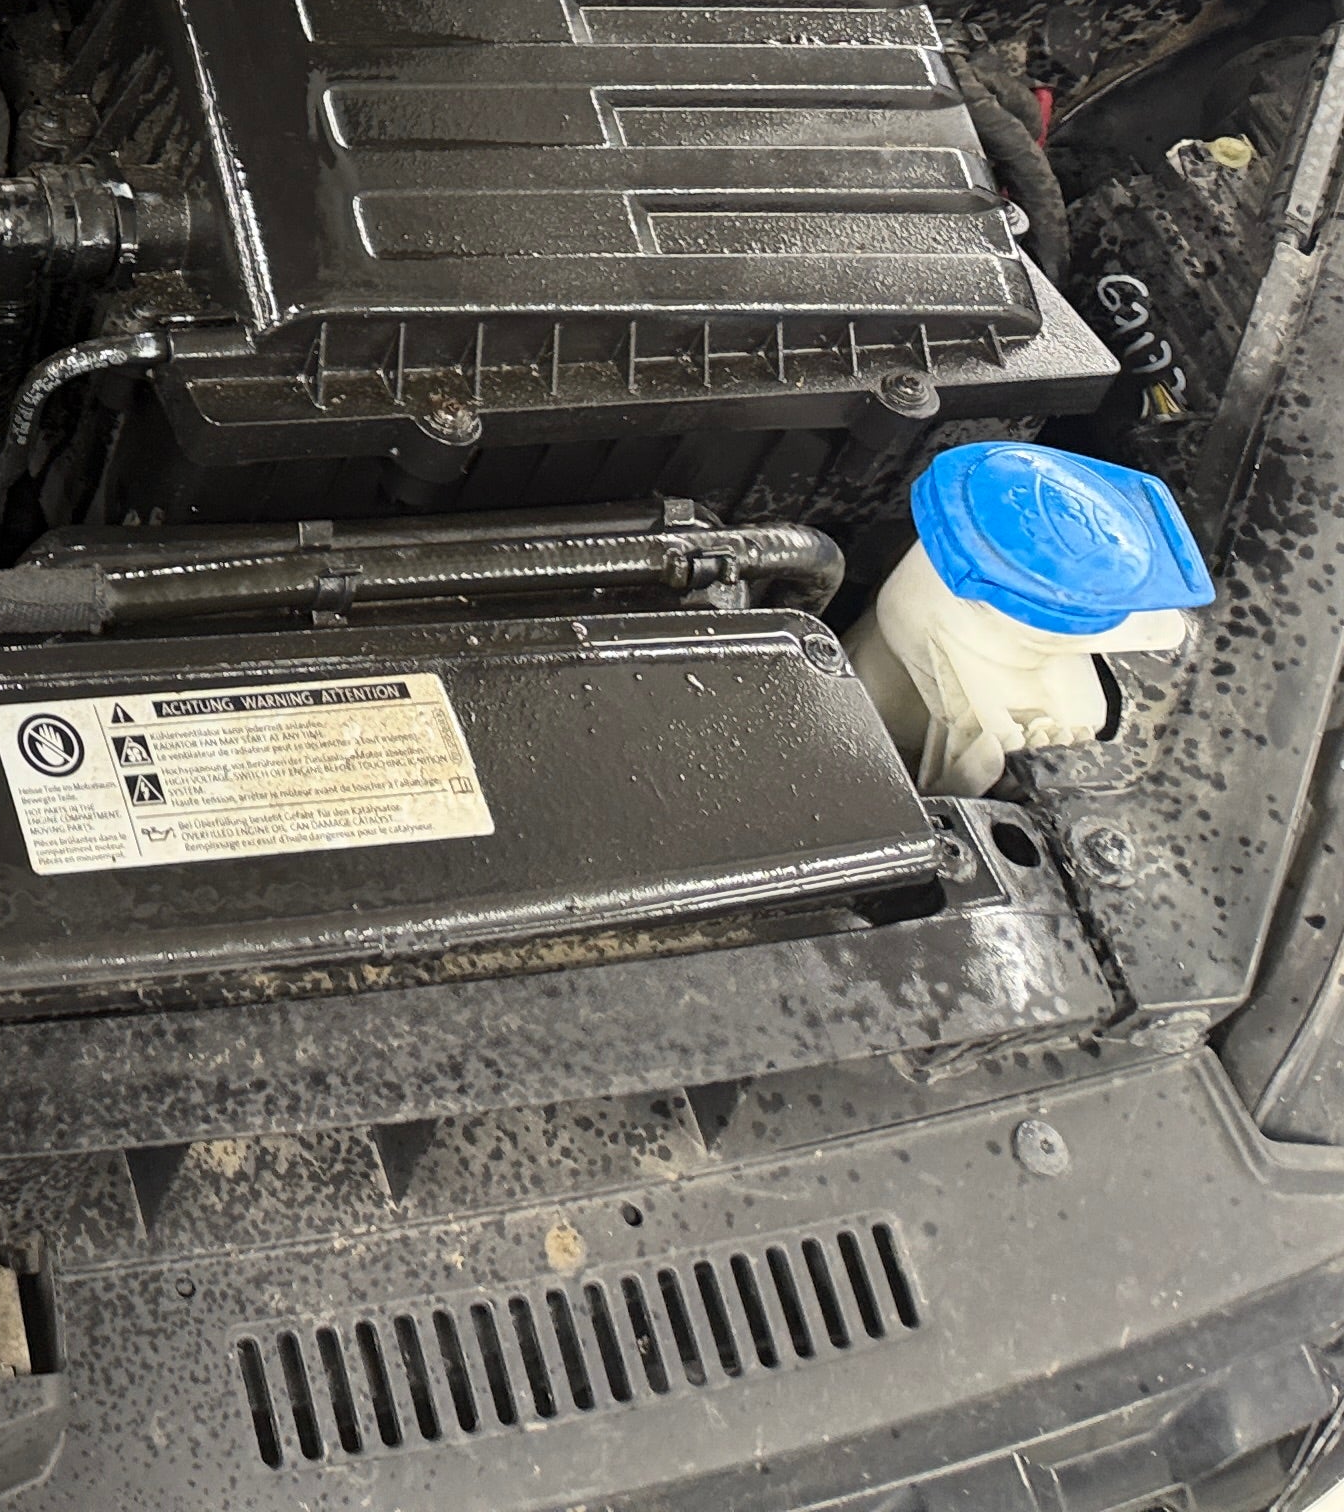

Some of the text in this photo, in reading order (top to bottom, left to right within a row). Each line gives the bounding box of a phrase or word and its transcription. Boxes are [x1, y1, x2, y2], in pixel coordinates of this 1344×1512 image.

[162, 685, 400, 715] ACHTUNG WARNING ATTENTION
